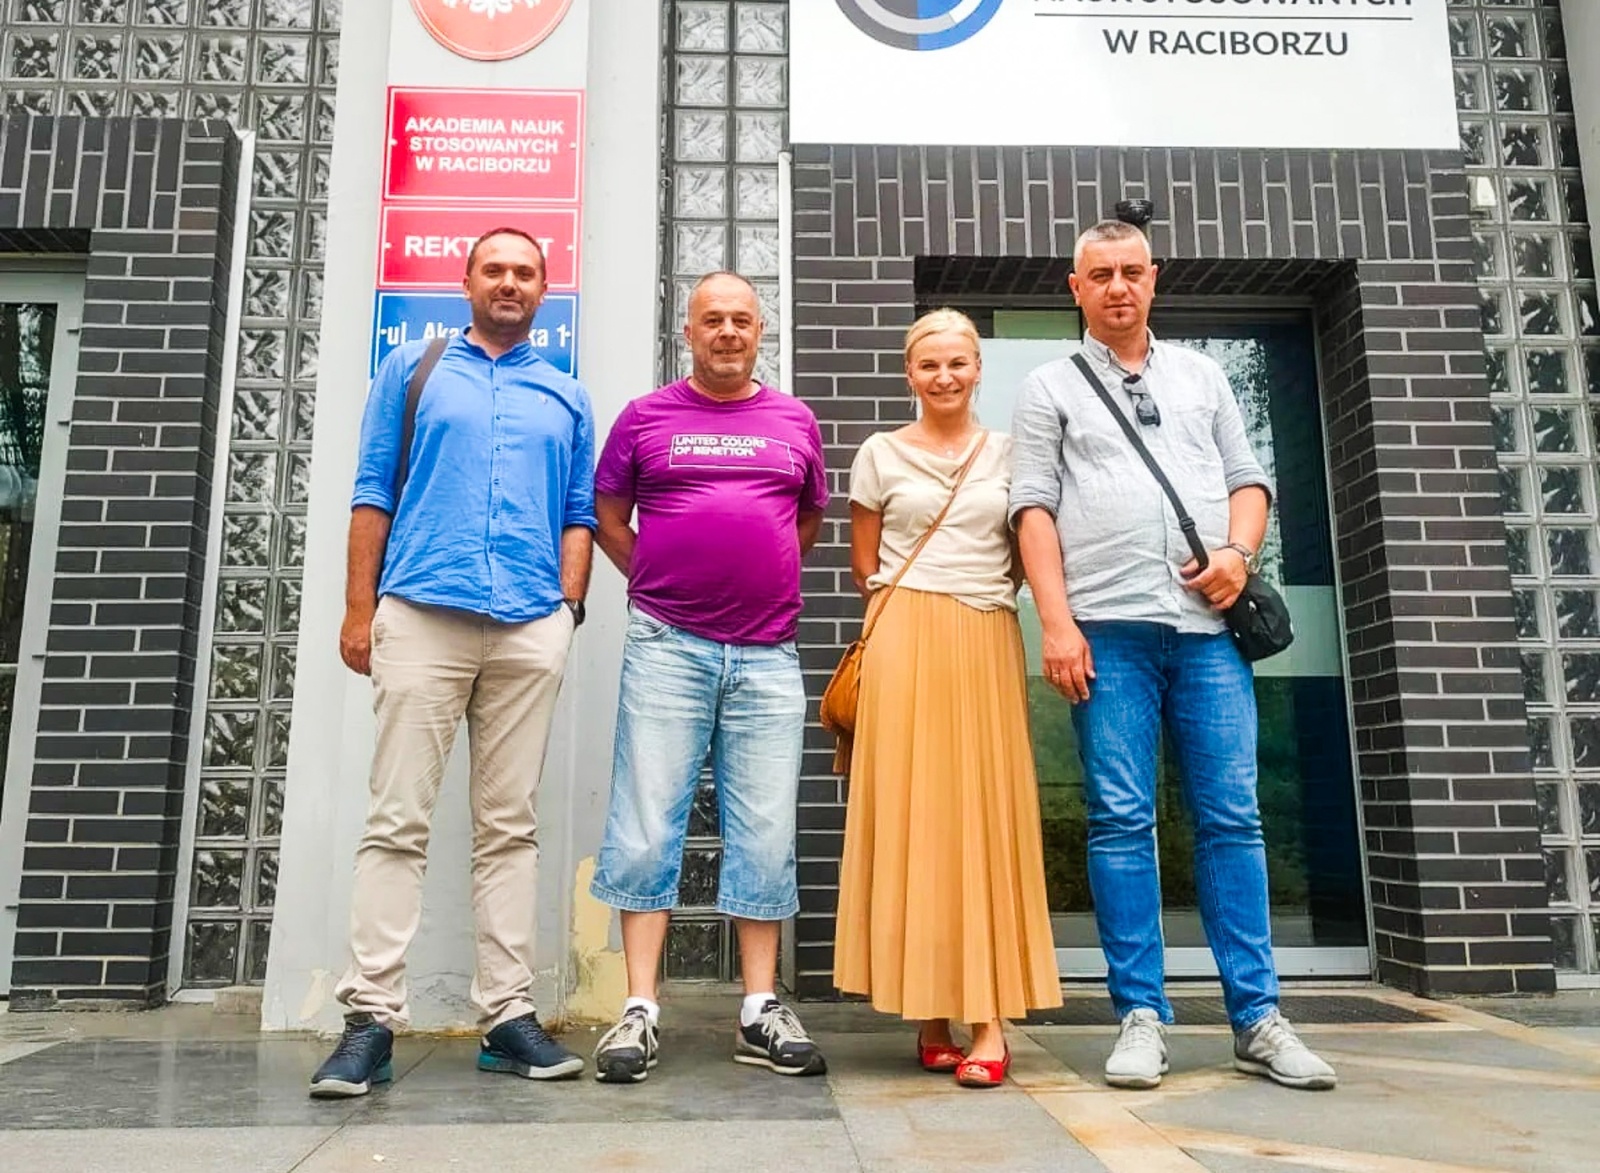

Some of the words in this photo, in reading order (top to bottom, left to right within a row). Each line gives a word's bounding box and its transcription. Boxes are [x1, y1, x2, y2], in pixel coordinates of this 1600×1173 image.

[1103, 29, 1139, 54] W
[1149, 30, 1348, 56] RACIBORZU
[405, 116, 507, 134] AKADEMIA
[511, 119, 565, 134] NAUK
[409, 136, 559, 154] STOSOWANYCH
[415, 155, 434, 171] W
[438, 156, 551, 173] RACIBORZU
[404, 235, 554, 258] REKTT
[556, 323, 567, 348] 1
[674, 446, 690, 455] OF
[675, 436, 718, 446] UNITED
[721, 436, 767, 448] COLORS
